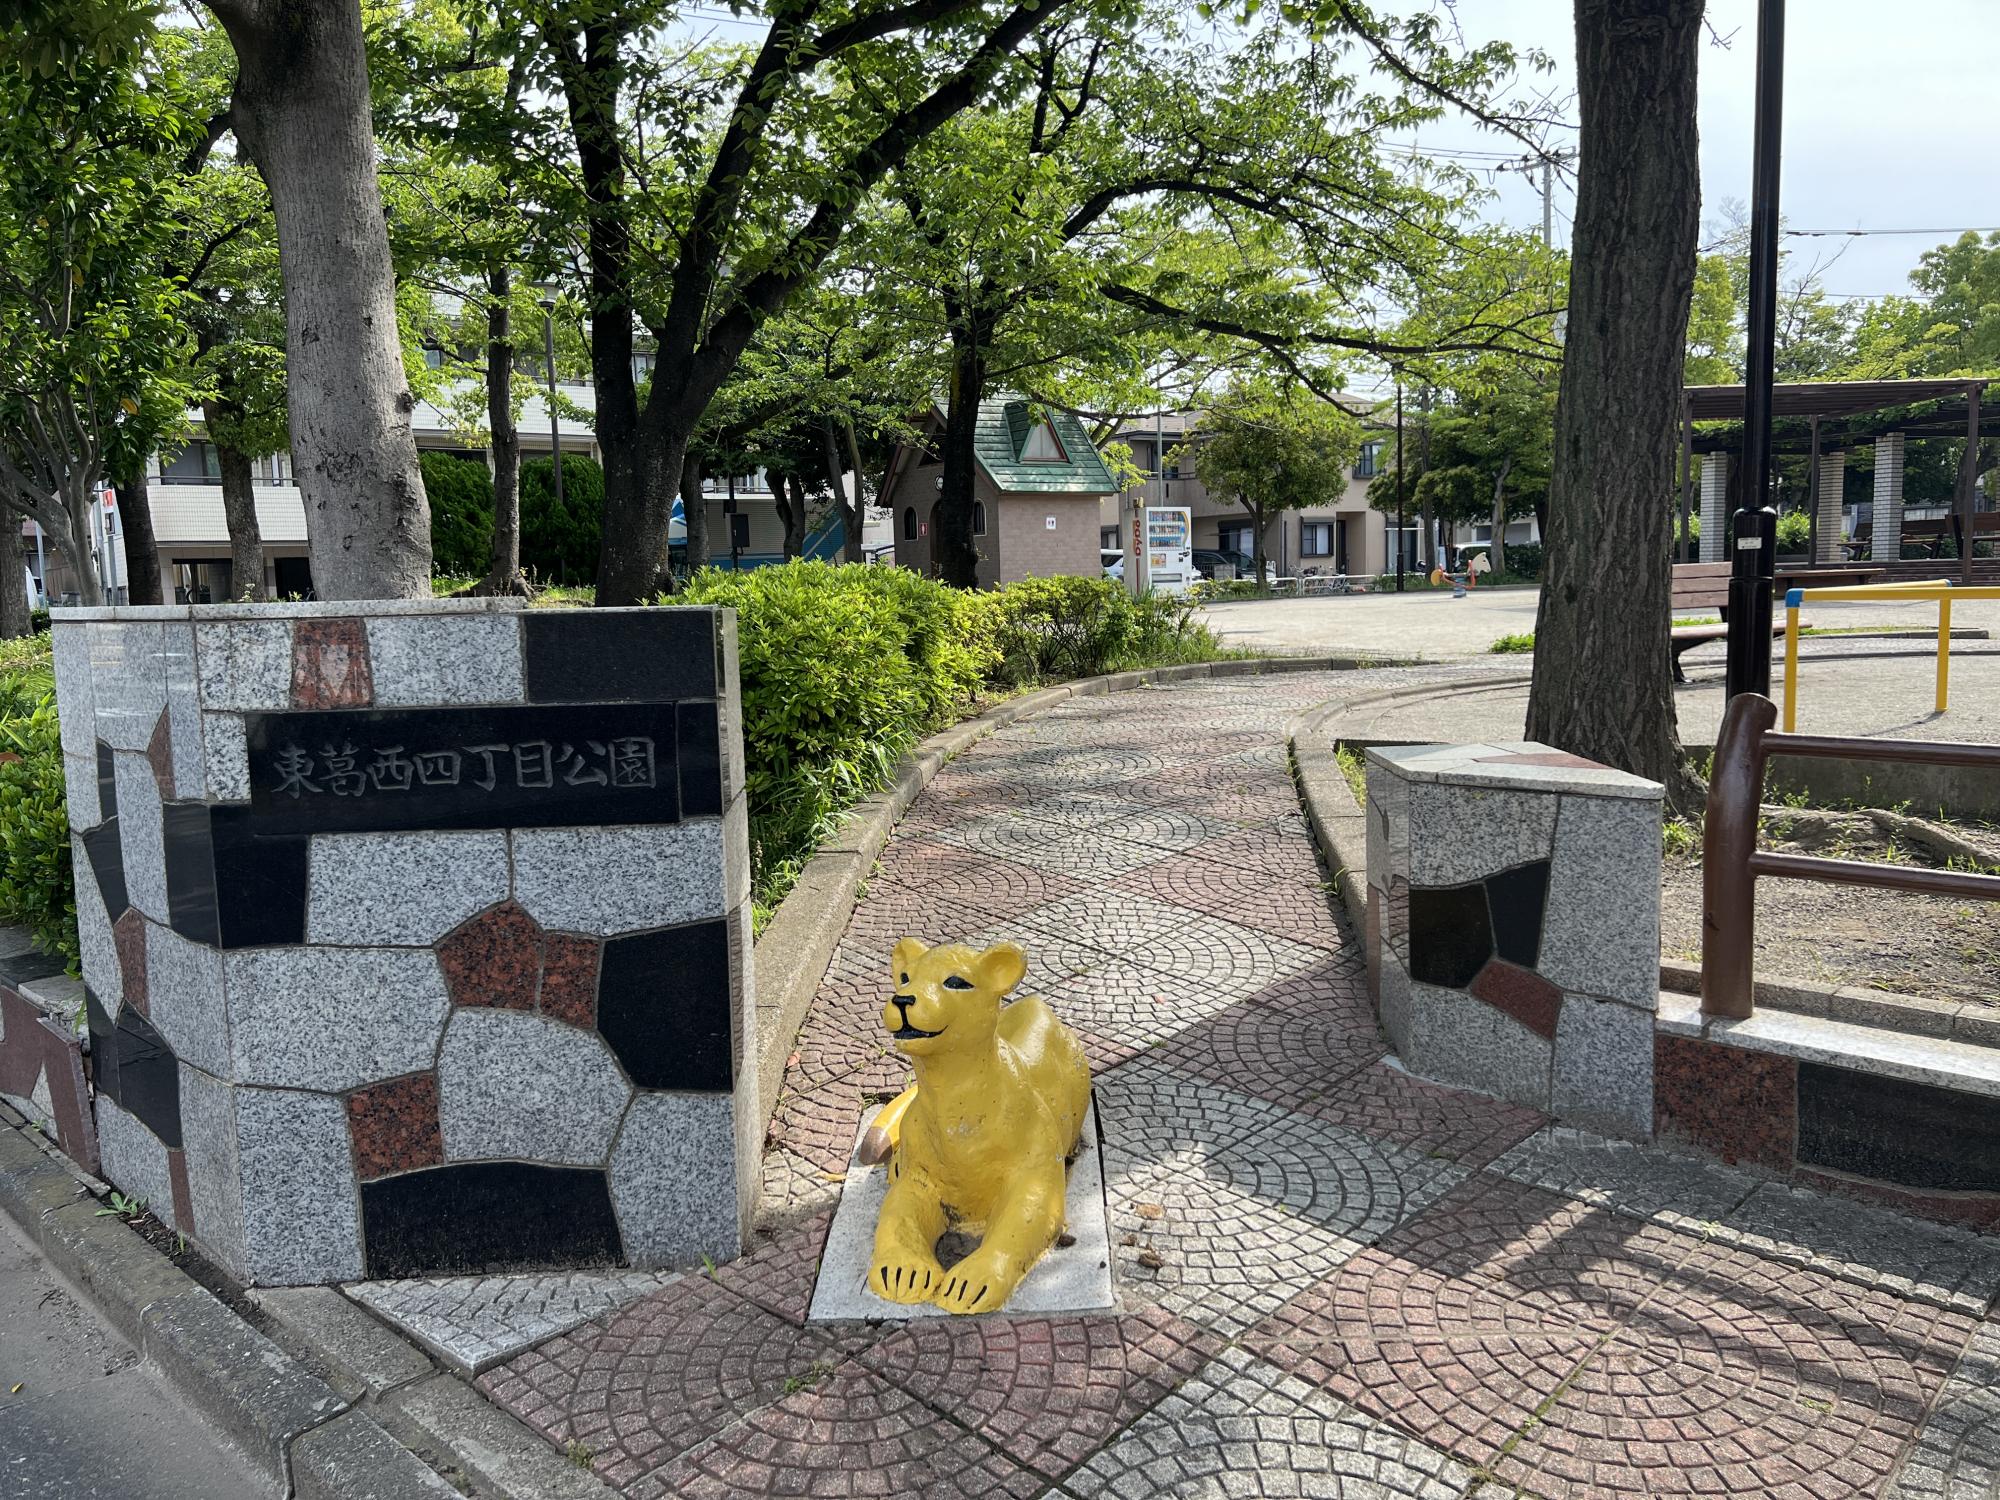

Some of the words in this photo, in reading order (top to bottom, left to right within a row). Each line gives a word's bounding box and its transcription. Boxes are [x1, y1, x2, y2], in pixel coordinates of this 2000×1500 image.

[272, 736, 657, 798] 東葛西四丁目公園
